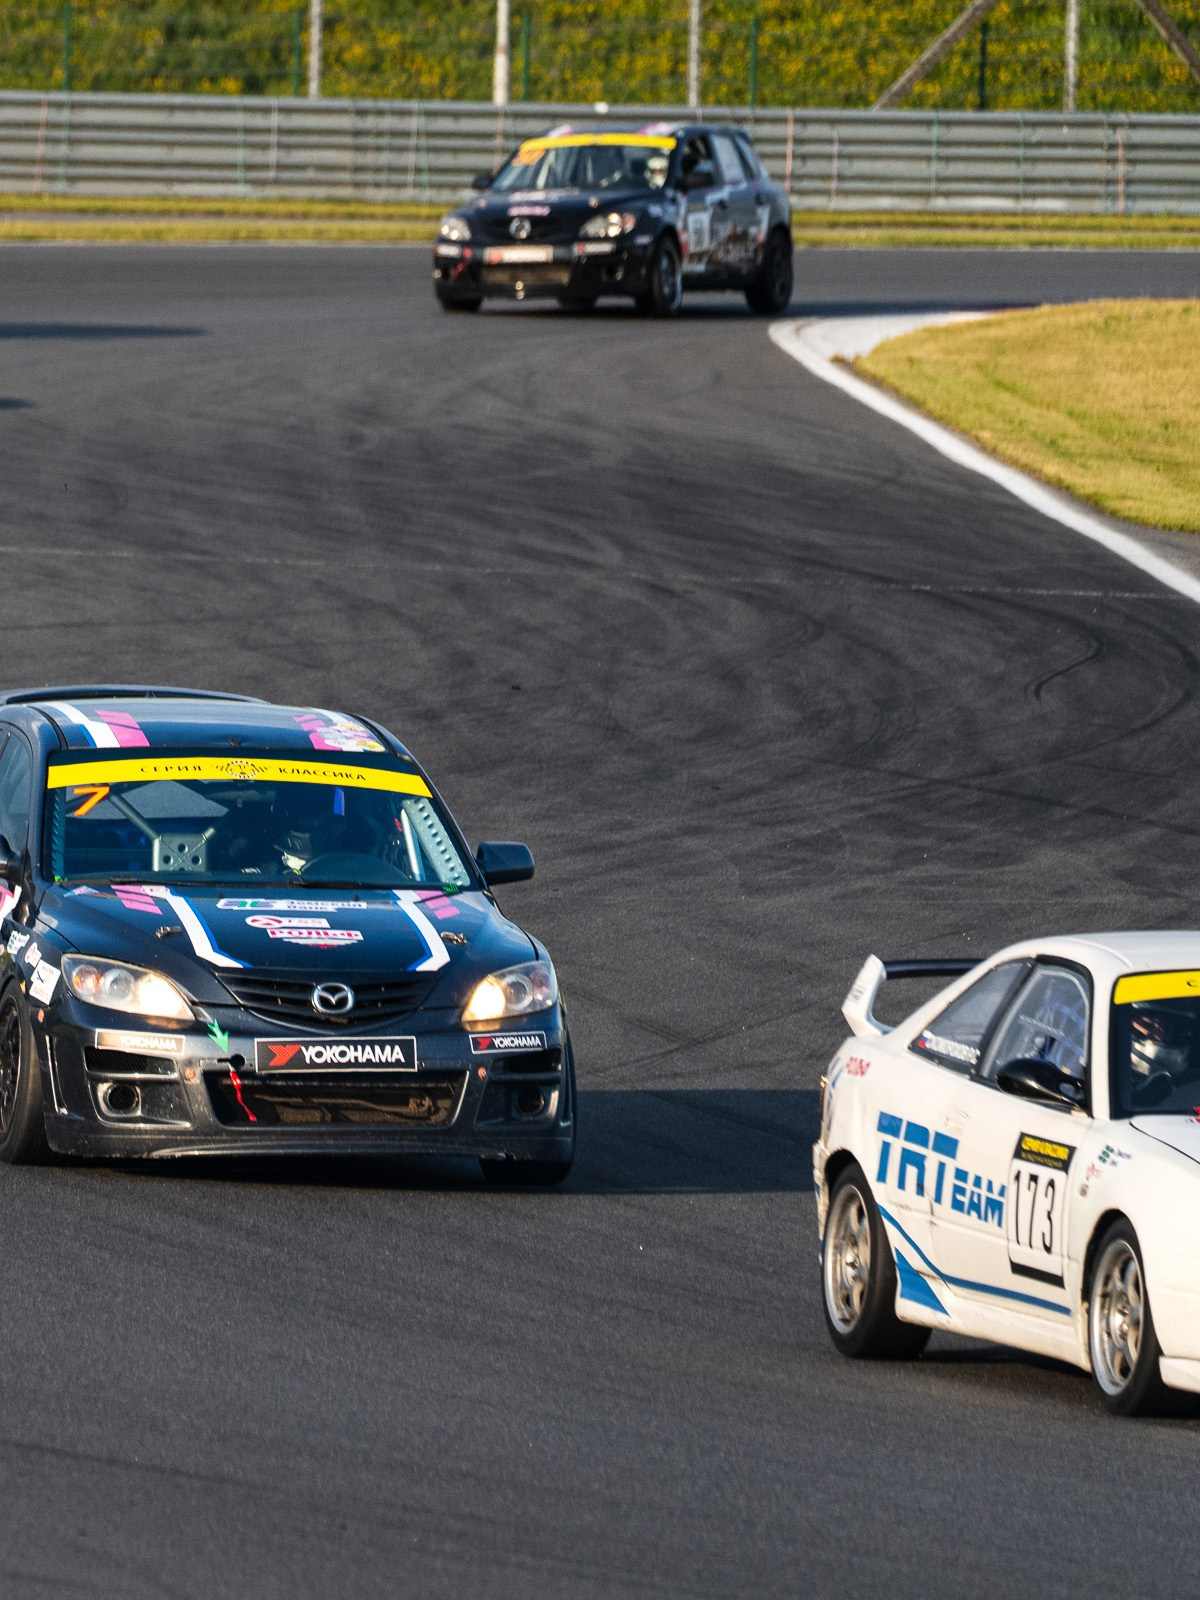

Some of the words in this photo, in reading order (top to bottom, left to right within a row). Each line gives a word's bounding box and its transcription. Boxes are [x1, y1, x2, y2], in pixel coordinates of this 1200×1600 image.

[140, 765, 202, 773] СЕРИЯ
[278, 767, 367, 781] КЛАССИКА
[73, 786, 110, 816] 7
[269, 930, 361, 938] РОЛЬФ
[120, 1036, 177, 1050] YOKOHAMA
[492, 1035, 542, 1048] YOKOHAMA
[301, 1044, 405, 1064] YOKOHAMA
[1014, 1170, 1056, 1254] 173
